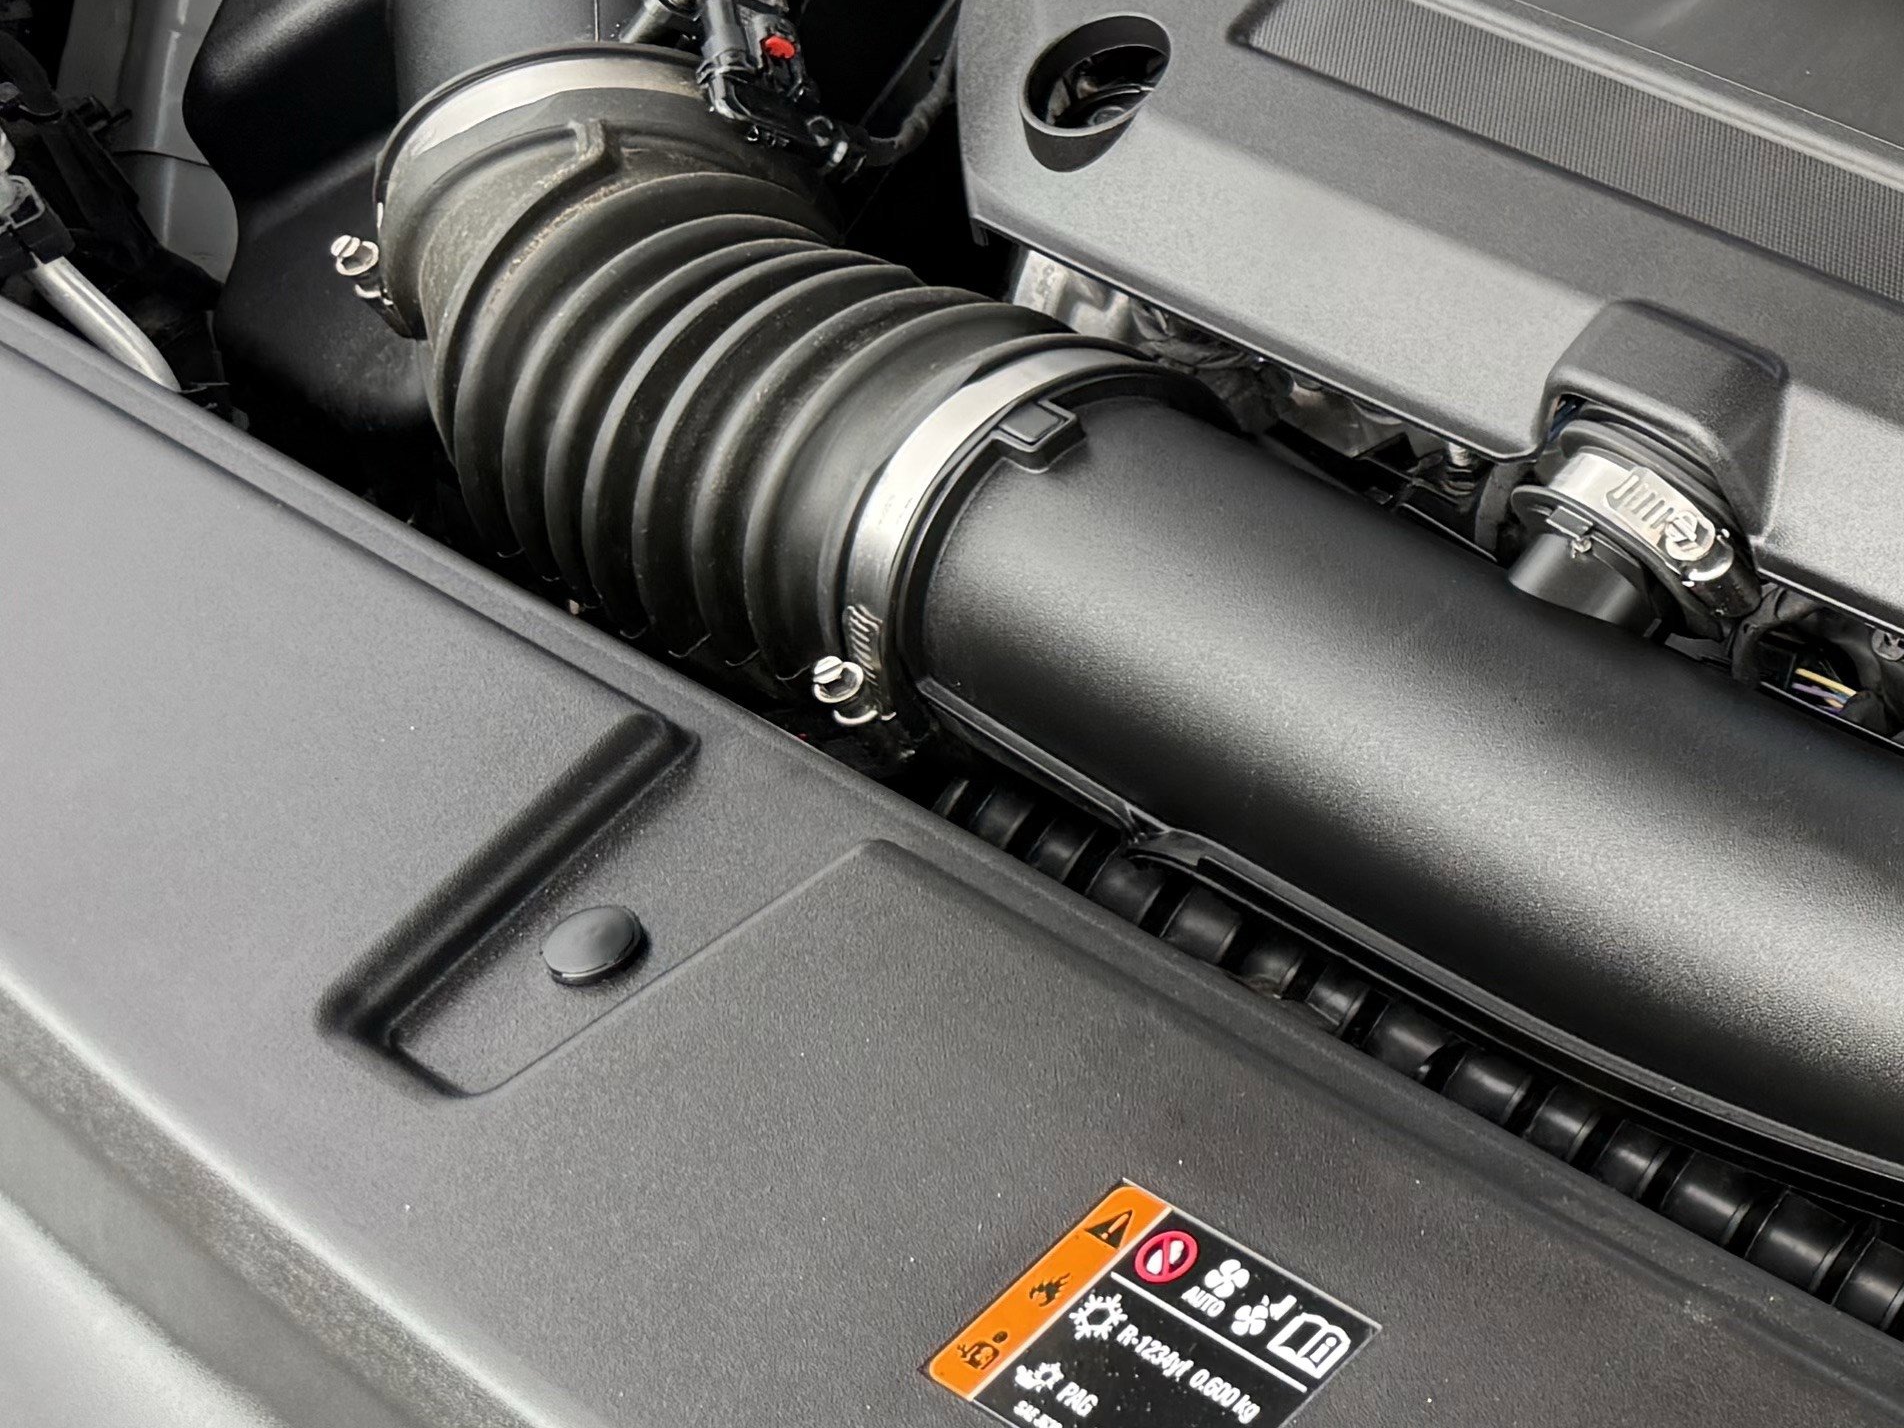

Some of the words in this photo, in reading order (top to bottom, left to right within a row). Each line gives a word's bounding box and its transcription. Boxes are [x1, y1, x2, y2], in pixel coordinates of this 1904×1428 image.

[1181, 1285, 1226, 1318] AUTO
[1116, 1323, 1195, 1381] R-1234yf
[1188, 1368, 1242, 1408] 0.600
[1231, 1394, 1261, 1424] kg
[1055, 1381, 1099, 1418] PAG
